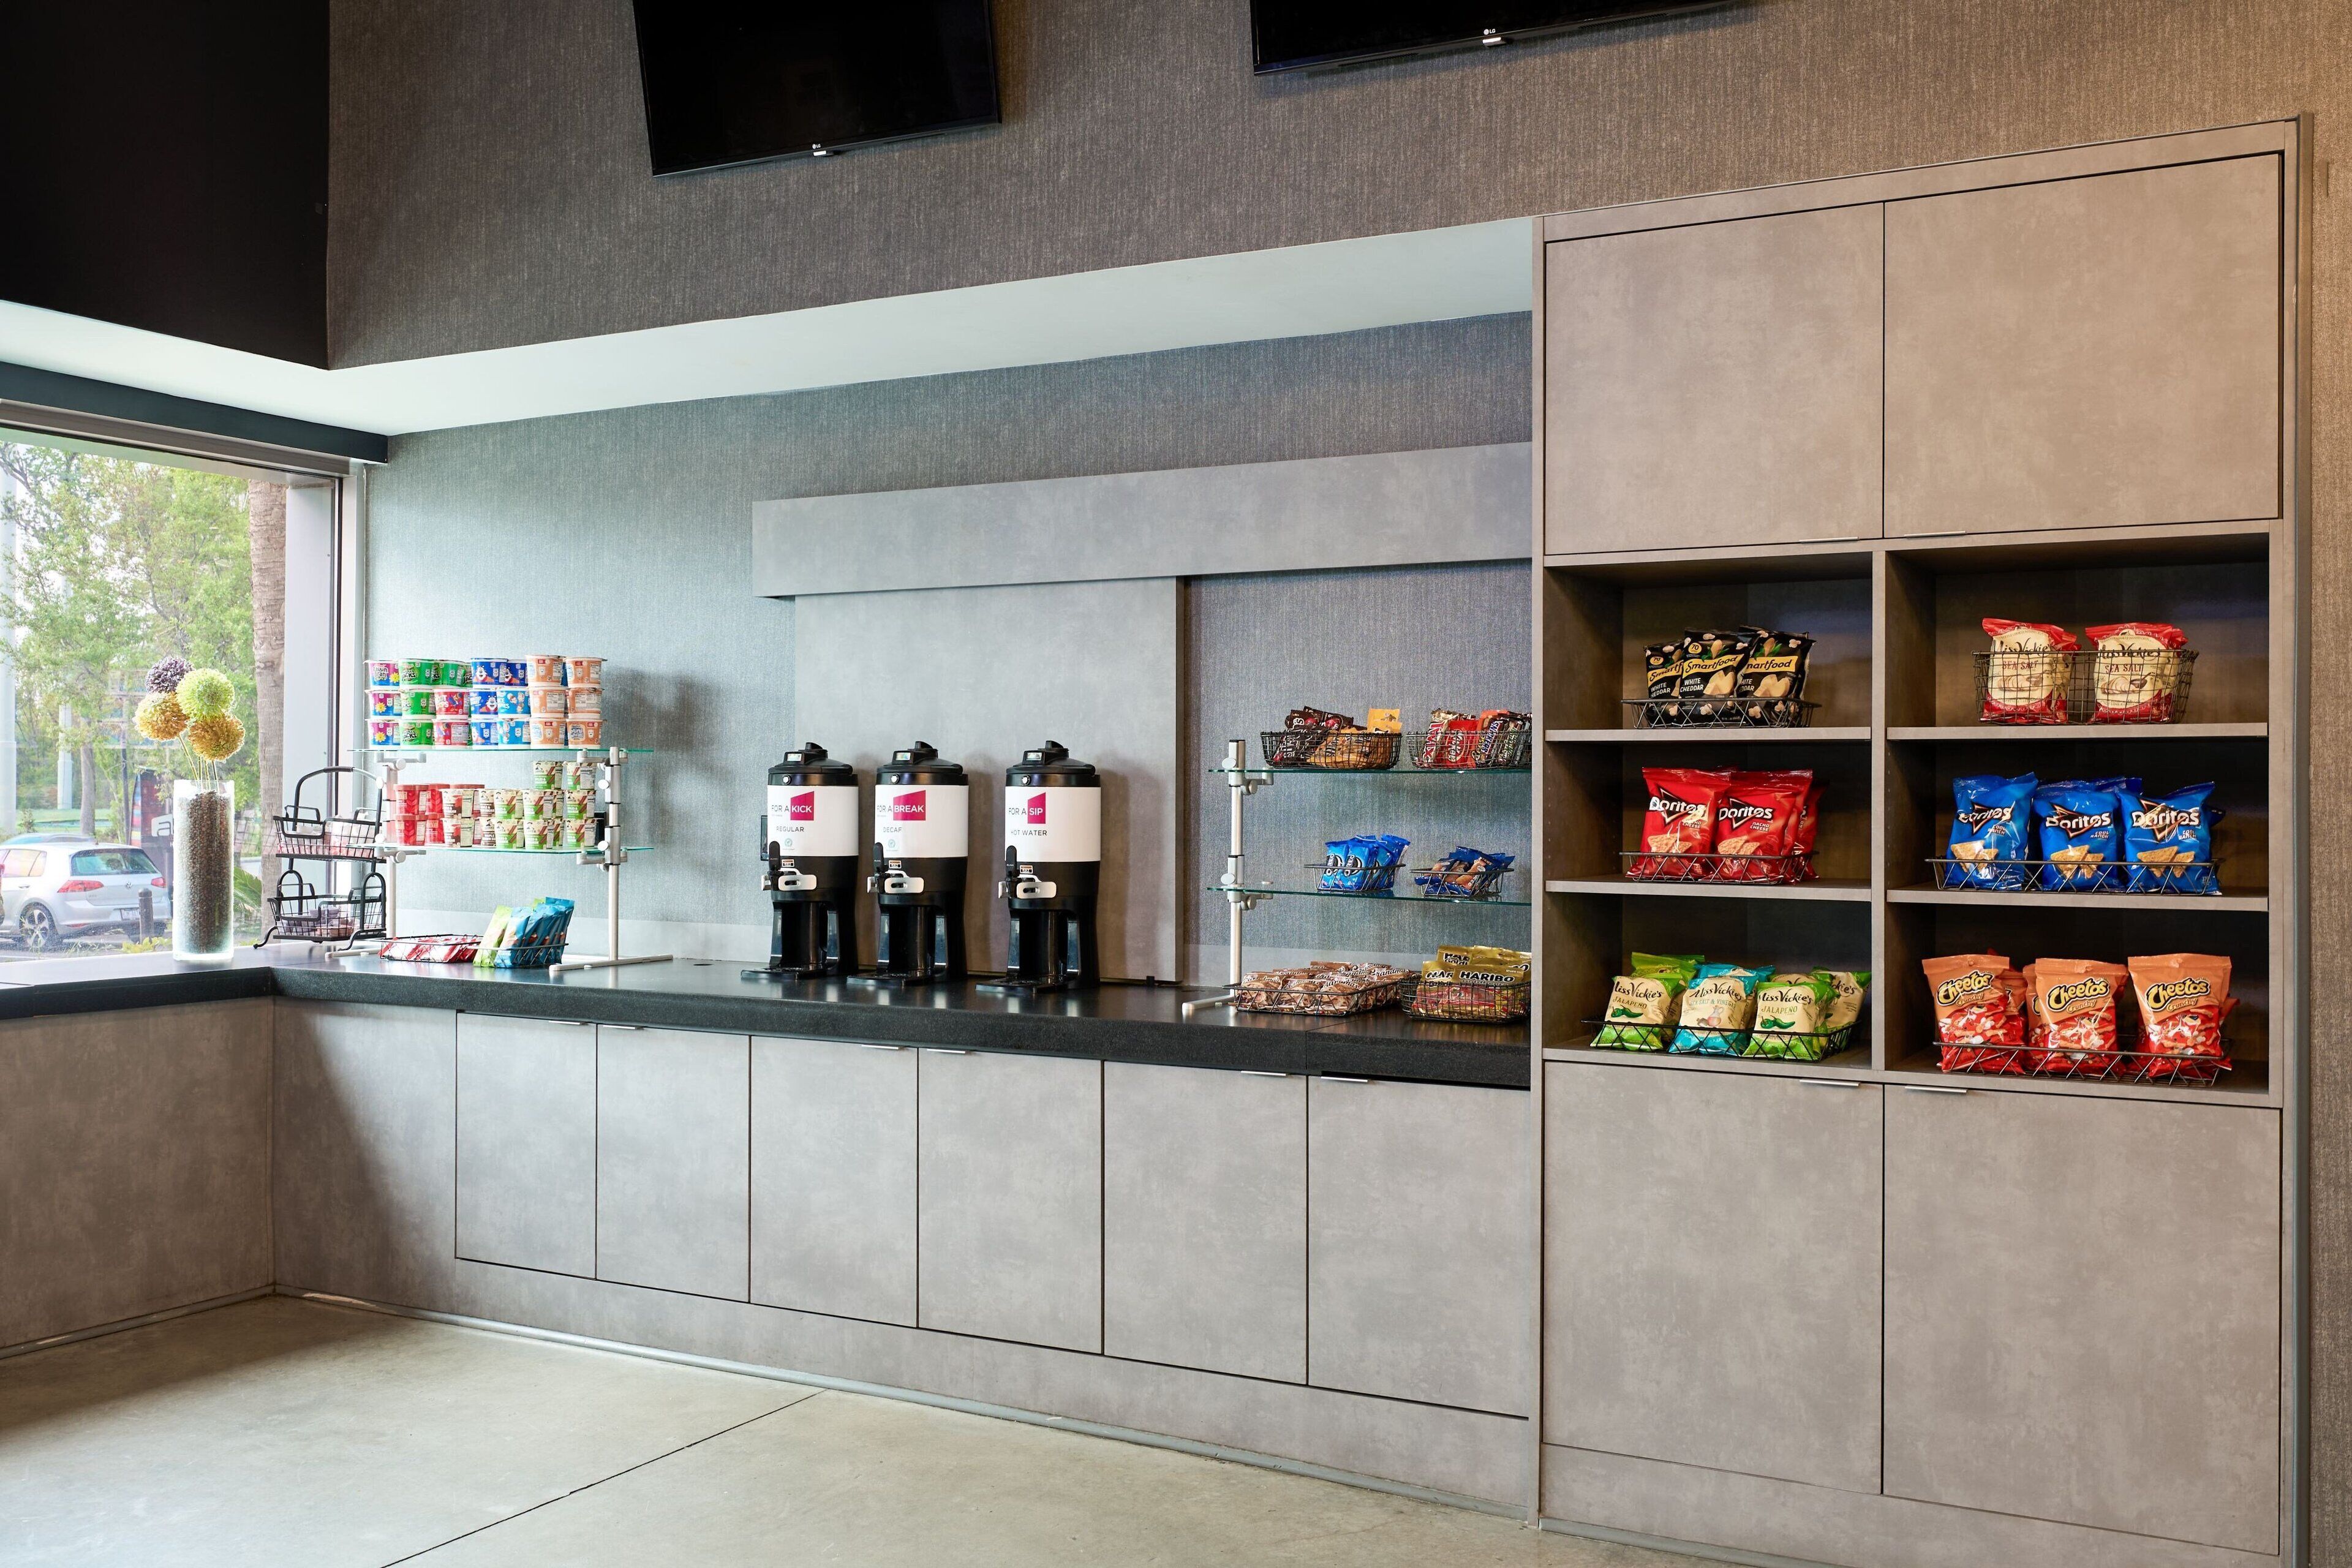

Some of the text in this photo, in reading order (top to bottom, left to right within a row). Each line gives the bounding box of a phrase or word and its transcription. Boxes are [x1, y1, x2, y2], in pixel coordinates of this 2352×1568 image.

[1685, 655, 1738, 673] Smartfood
[2021, 660, 2038, 670] SALT
[2123, 663, 2143, 673] SALT
[1650, 682, 1667, 693] WHITE
[1679, 684, 1704, 693] CHEDDAR
[894, 804, 925, 813] BREAK
[1029, 807, 1043, 816] SIP
[1649, 796, 1707, 816] Doritos
[1718, 806, 1773, 821] Doritos
[2046, 812, 2111, 829] Doritos
[2132, 810, 2199, 827] Doritos
[1460, 971, 1514, 982] HARIBO
[1630, 982, 1663, 1002] Vickie's
[1937, 971, 1994, 1005] Cheetos
[2048, 978, 2109, 1011] Cheetos
[2146, 978, 2209, 1010] Cheetos
[1777, 988, 1813, 1005] Vickie's
[1957, 993, 1984, 1006] Crunchy
[2067, 999, 2097, 1012] Crunchy
[2167, 997, 2198, 1012] Crunchy
